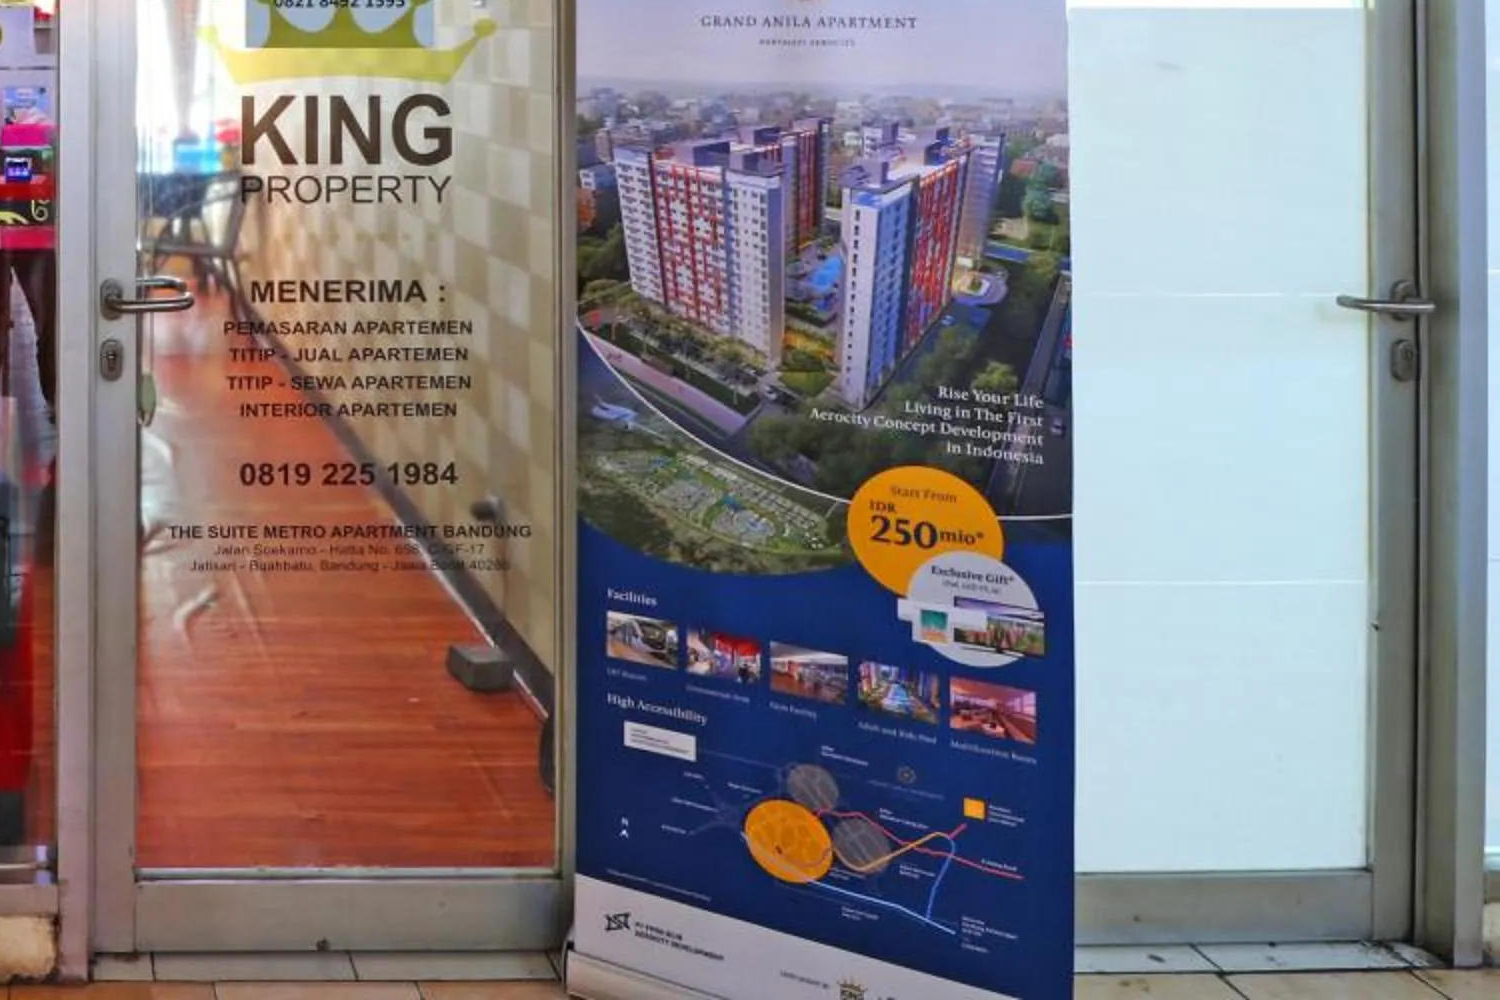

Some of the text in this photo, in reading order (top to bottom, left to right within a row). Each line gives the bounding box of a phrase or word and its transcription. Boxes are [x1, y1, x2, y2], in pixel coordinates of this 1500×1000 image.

[700, 15, 918, 30] GRAND ANILA APARTMENT
[240, 93, 453, 167] KING
[241, 174, 453, 204] PROPERTY
[250, 279, 428, 304] MENERIMA
[223, 320, 473, 336] PEMASARAN APARTEMEN
[229, 347, 276, 362] TITIP
[293, 347, 343, 362] JUAL
[348, 347, 469, 362] APARTEMEN
[226, 375, 273, 390] TITIP
[290, 375, 348, 390] SEWA
[350, 375, 472, 390] APARTEMEN
[938, 386, 1044, 409] Rise Your Life
[239, 403, 457, 418] INTERIOR APARTEMEN
[904, 400, 1043, 427] Living in The First
[809, 407, 1044, 447] Aerocity Concept Development
[947, 442, 1044, 466] in Indonesia
[239, 462, 459, 487] 0819 225 1984
[869, 499, 897, 514] IDR
[169, 525, 533, 539] THE SUITE METRO APARTMENT BANDUNG
[931, 565, 983, 582] Exclusive
[607, 587, 658, 607] Facilities
[607, 692, 708, 727] High Accessibility
